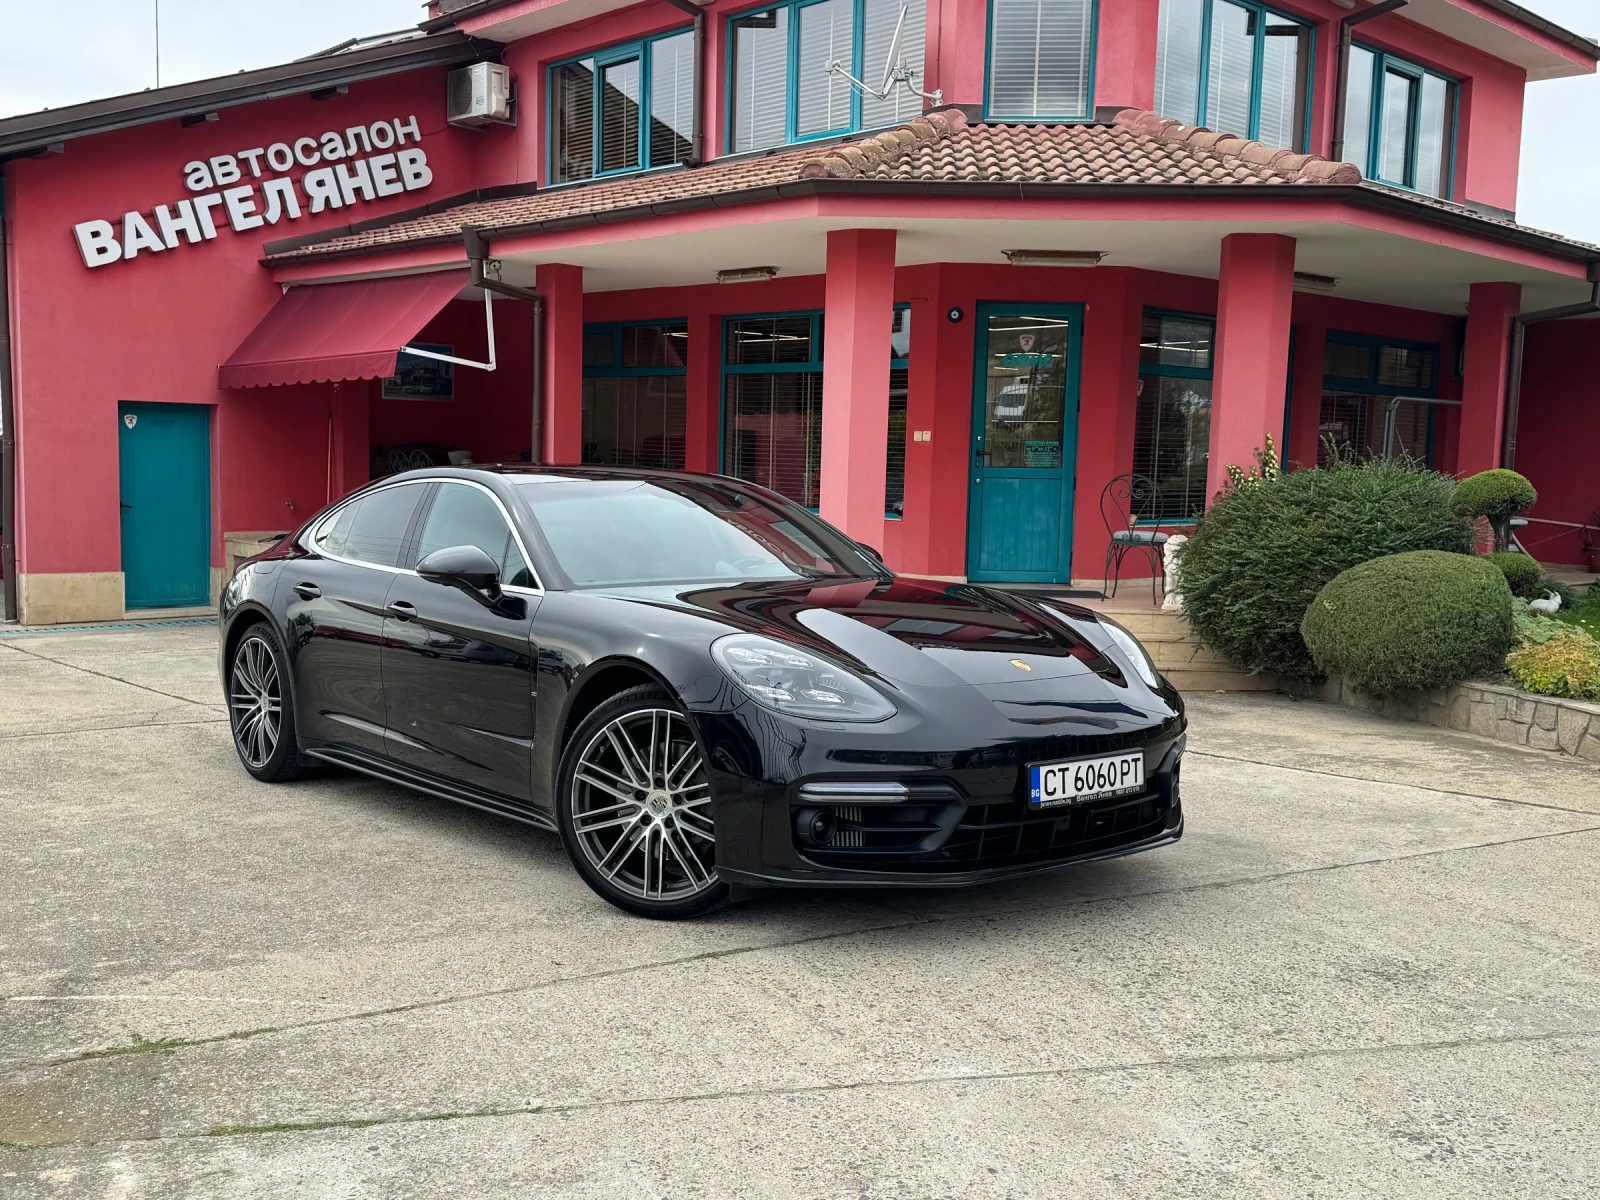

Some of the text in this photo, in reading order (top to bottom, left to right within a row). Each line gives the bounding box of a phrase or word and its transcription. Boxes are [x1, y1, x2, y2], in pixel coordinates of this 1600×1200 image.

[183, 115, 422, 192] автосалон
[73, 148, 433, 268] ВАНГЕЛ ЯНЕВ
[1031, 788, 1040, 798] BG
[1074, 761, 1117, 792] 6060
